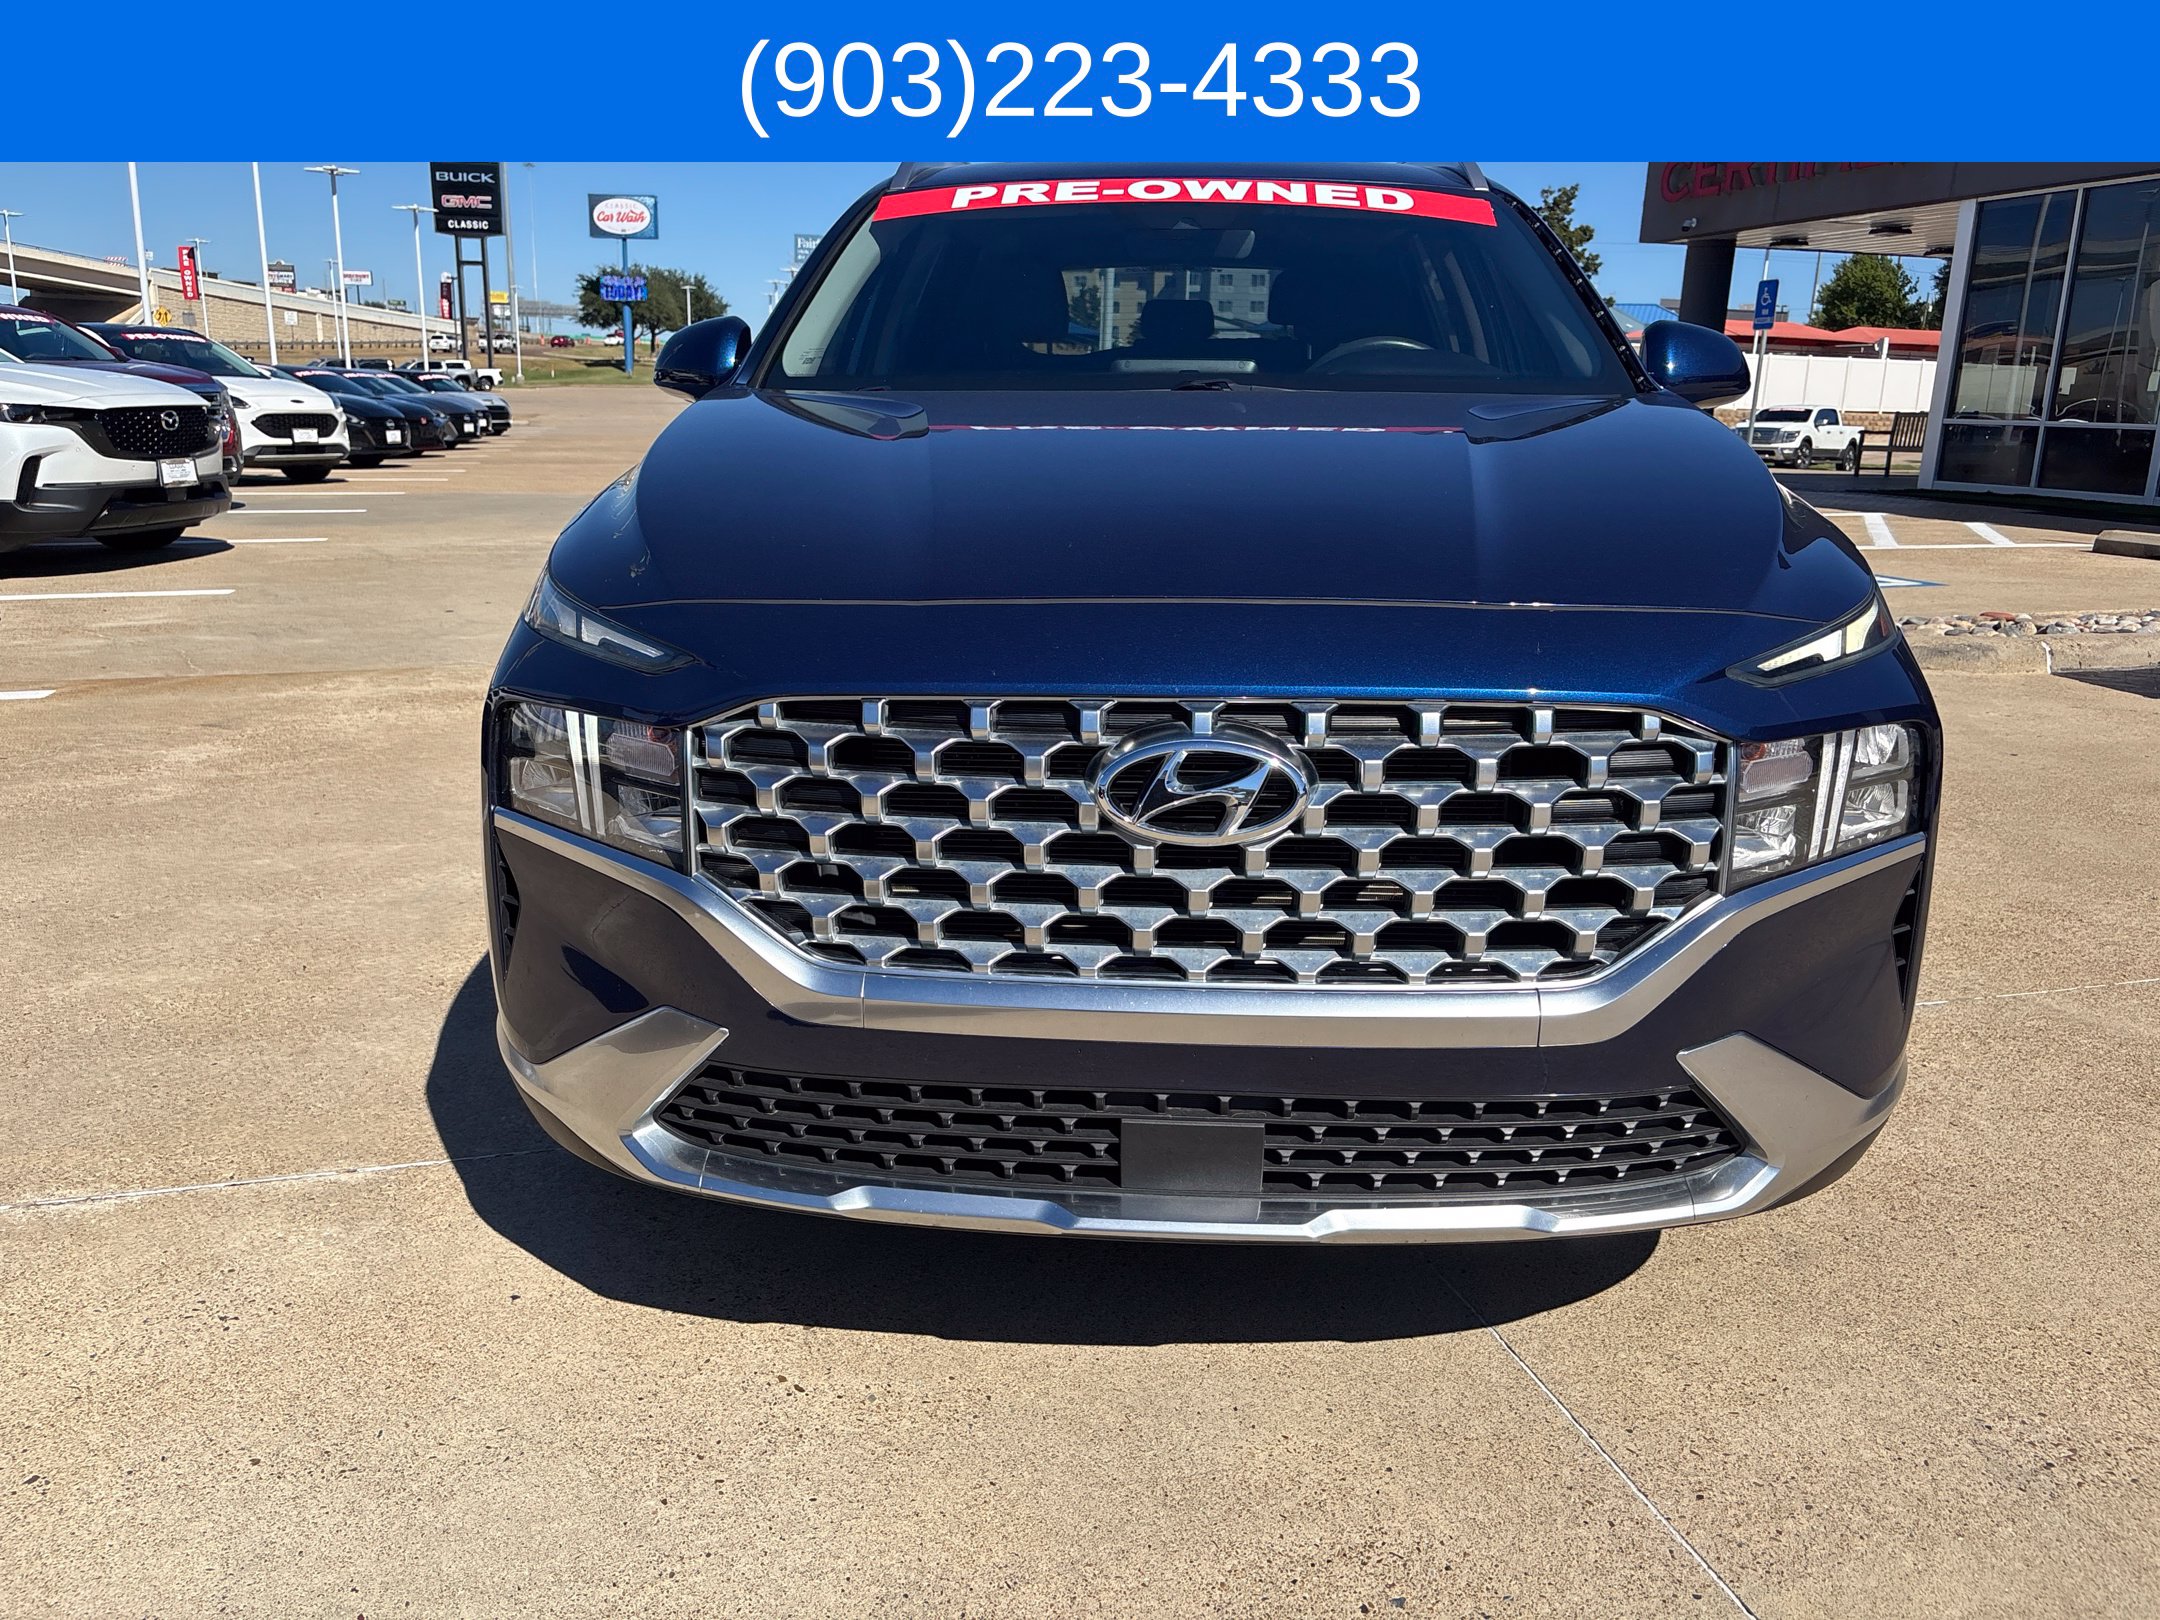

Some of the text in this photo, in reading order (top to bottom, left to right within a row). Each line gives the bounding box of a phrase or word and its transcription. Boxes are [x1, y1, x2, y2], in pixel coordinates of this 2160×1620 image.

[435, 171, 496, 184] BUICK
[441, 194, 493, 209] GMC
[951, 179, 1415, 210] PRE-OWNED
[597, 209, 647, 223] Car Wash
[447, 219, 489, 230] CLASSIC
